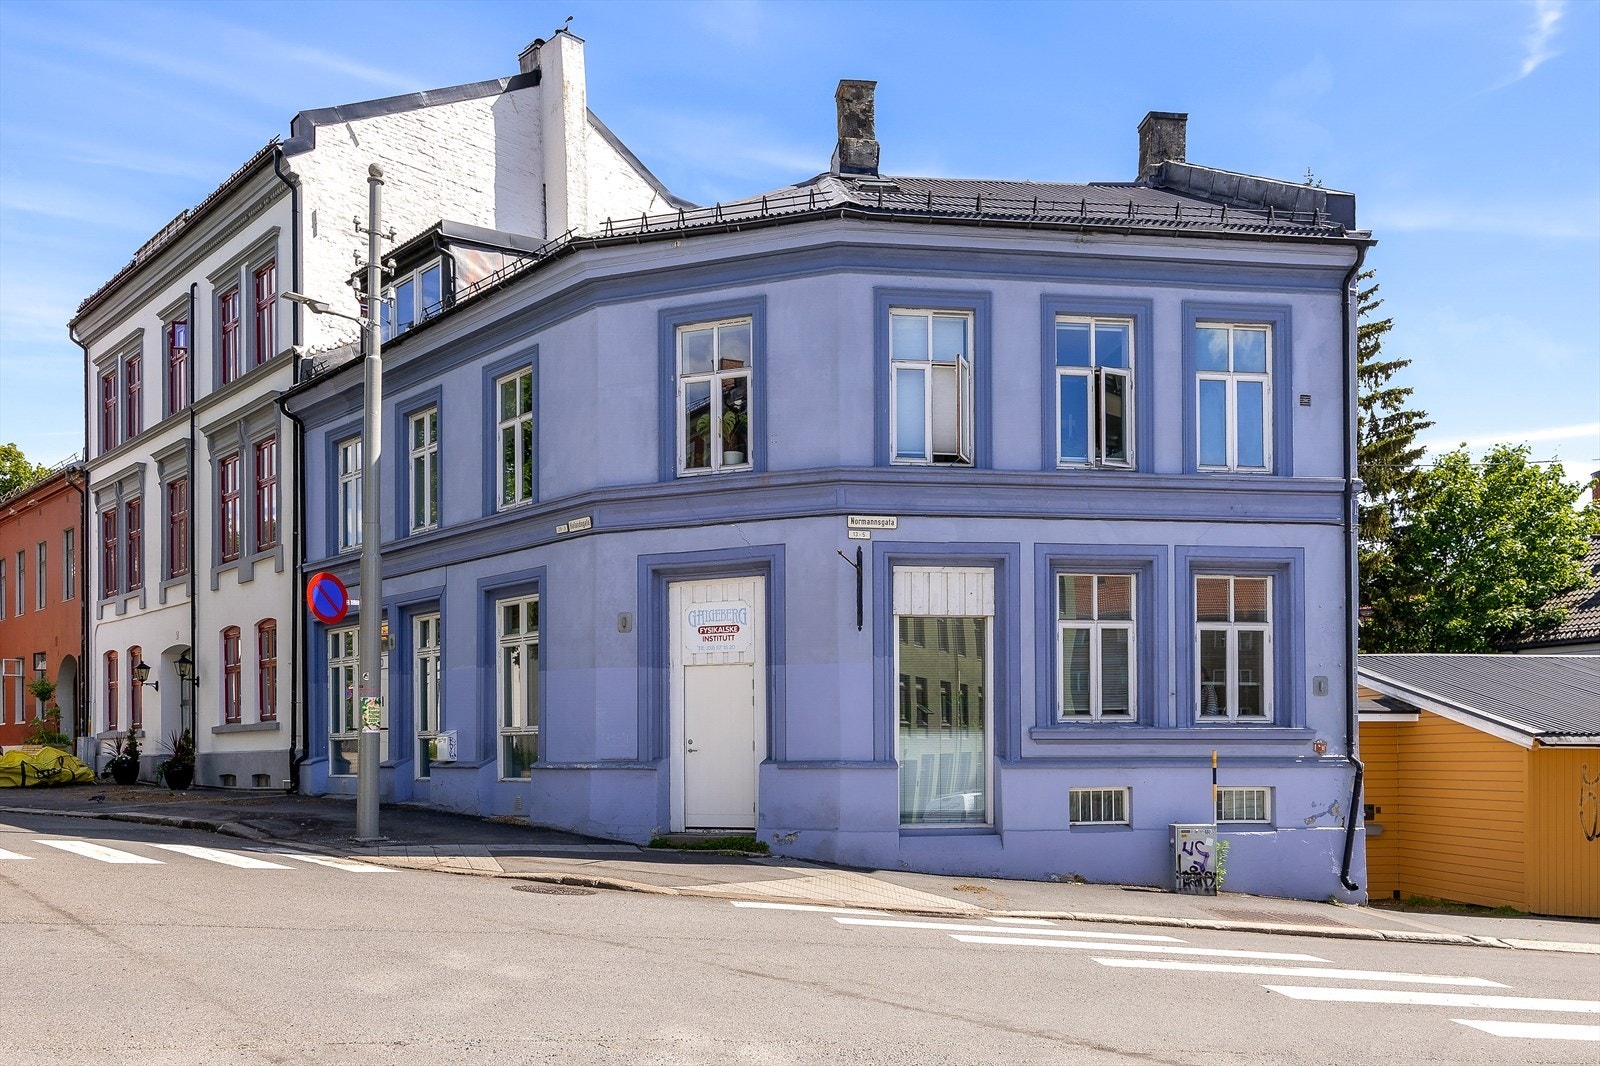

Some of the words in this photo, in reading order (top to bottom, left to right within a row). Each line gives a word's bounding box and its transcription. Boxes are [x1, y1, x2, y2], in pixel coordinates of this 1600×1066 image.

[850, 517, 895, 527] Normannsgata
[688, 608, 747, 627] GALGEBERG
[702, 634, 735, 642] INSTITUTT
